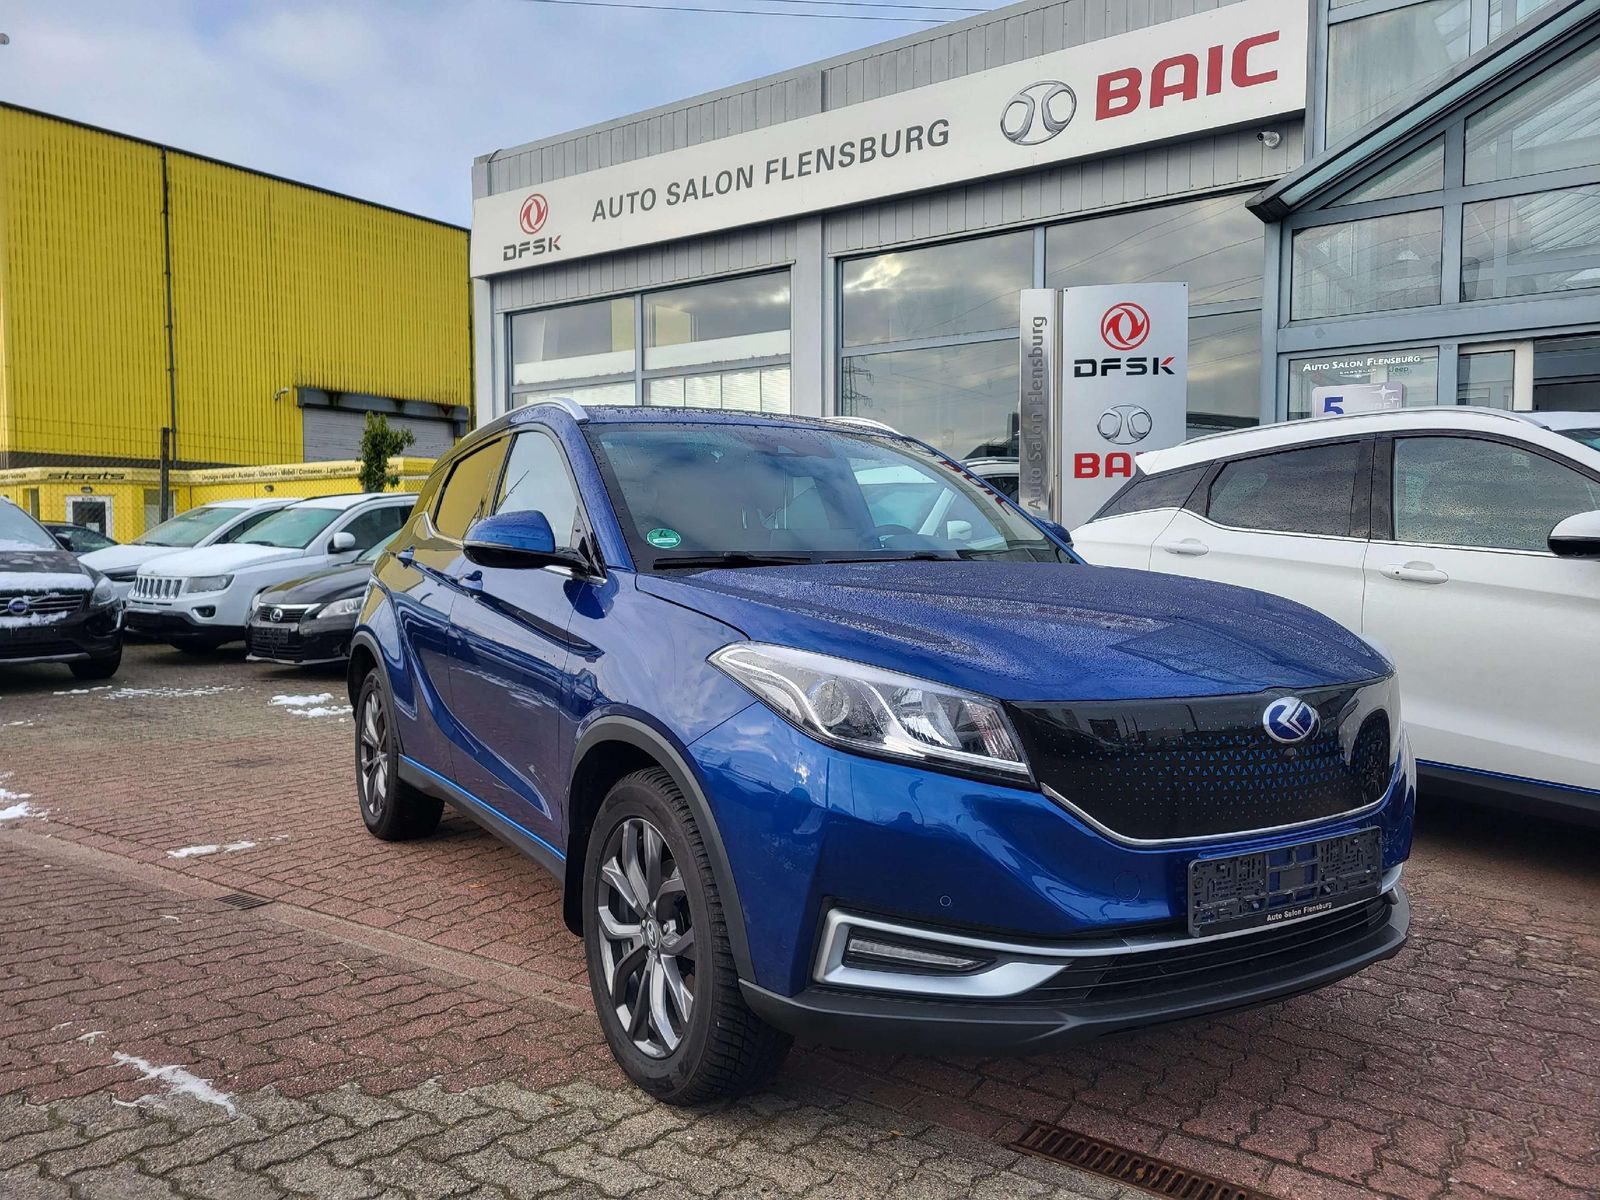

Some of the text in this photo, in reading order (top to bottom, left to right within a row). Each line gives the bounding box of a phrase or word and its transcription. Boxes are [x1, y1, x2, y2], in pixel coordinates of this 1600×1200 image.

[1095, 30, 1280, 121] BAIC
[592, 118, 950, 223] AUTO SALON FLENSBURG
[503, 234, 562, 262] DFSK
[1027, 316, 1048, 406] Flensburg
[1074, 356, 1176, 378] DFSK
[1323, 396, 1344, 415] 5
[1028, 411, 1043, 463] Salon
[1266, 902, 1332, 922] Auto Salon Flensburg
